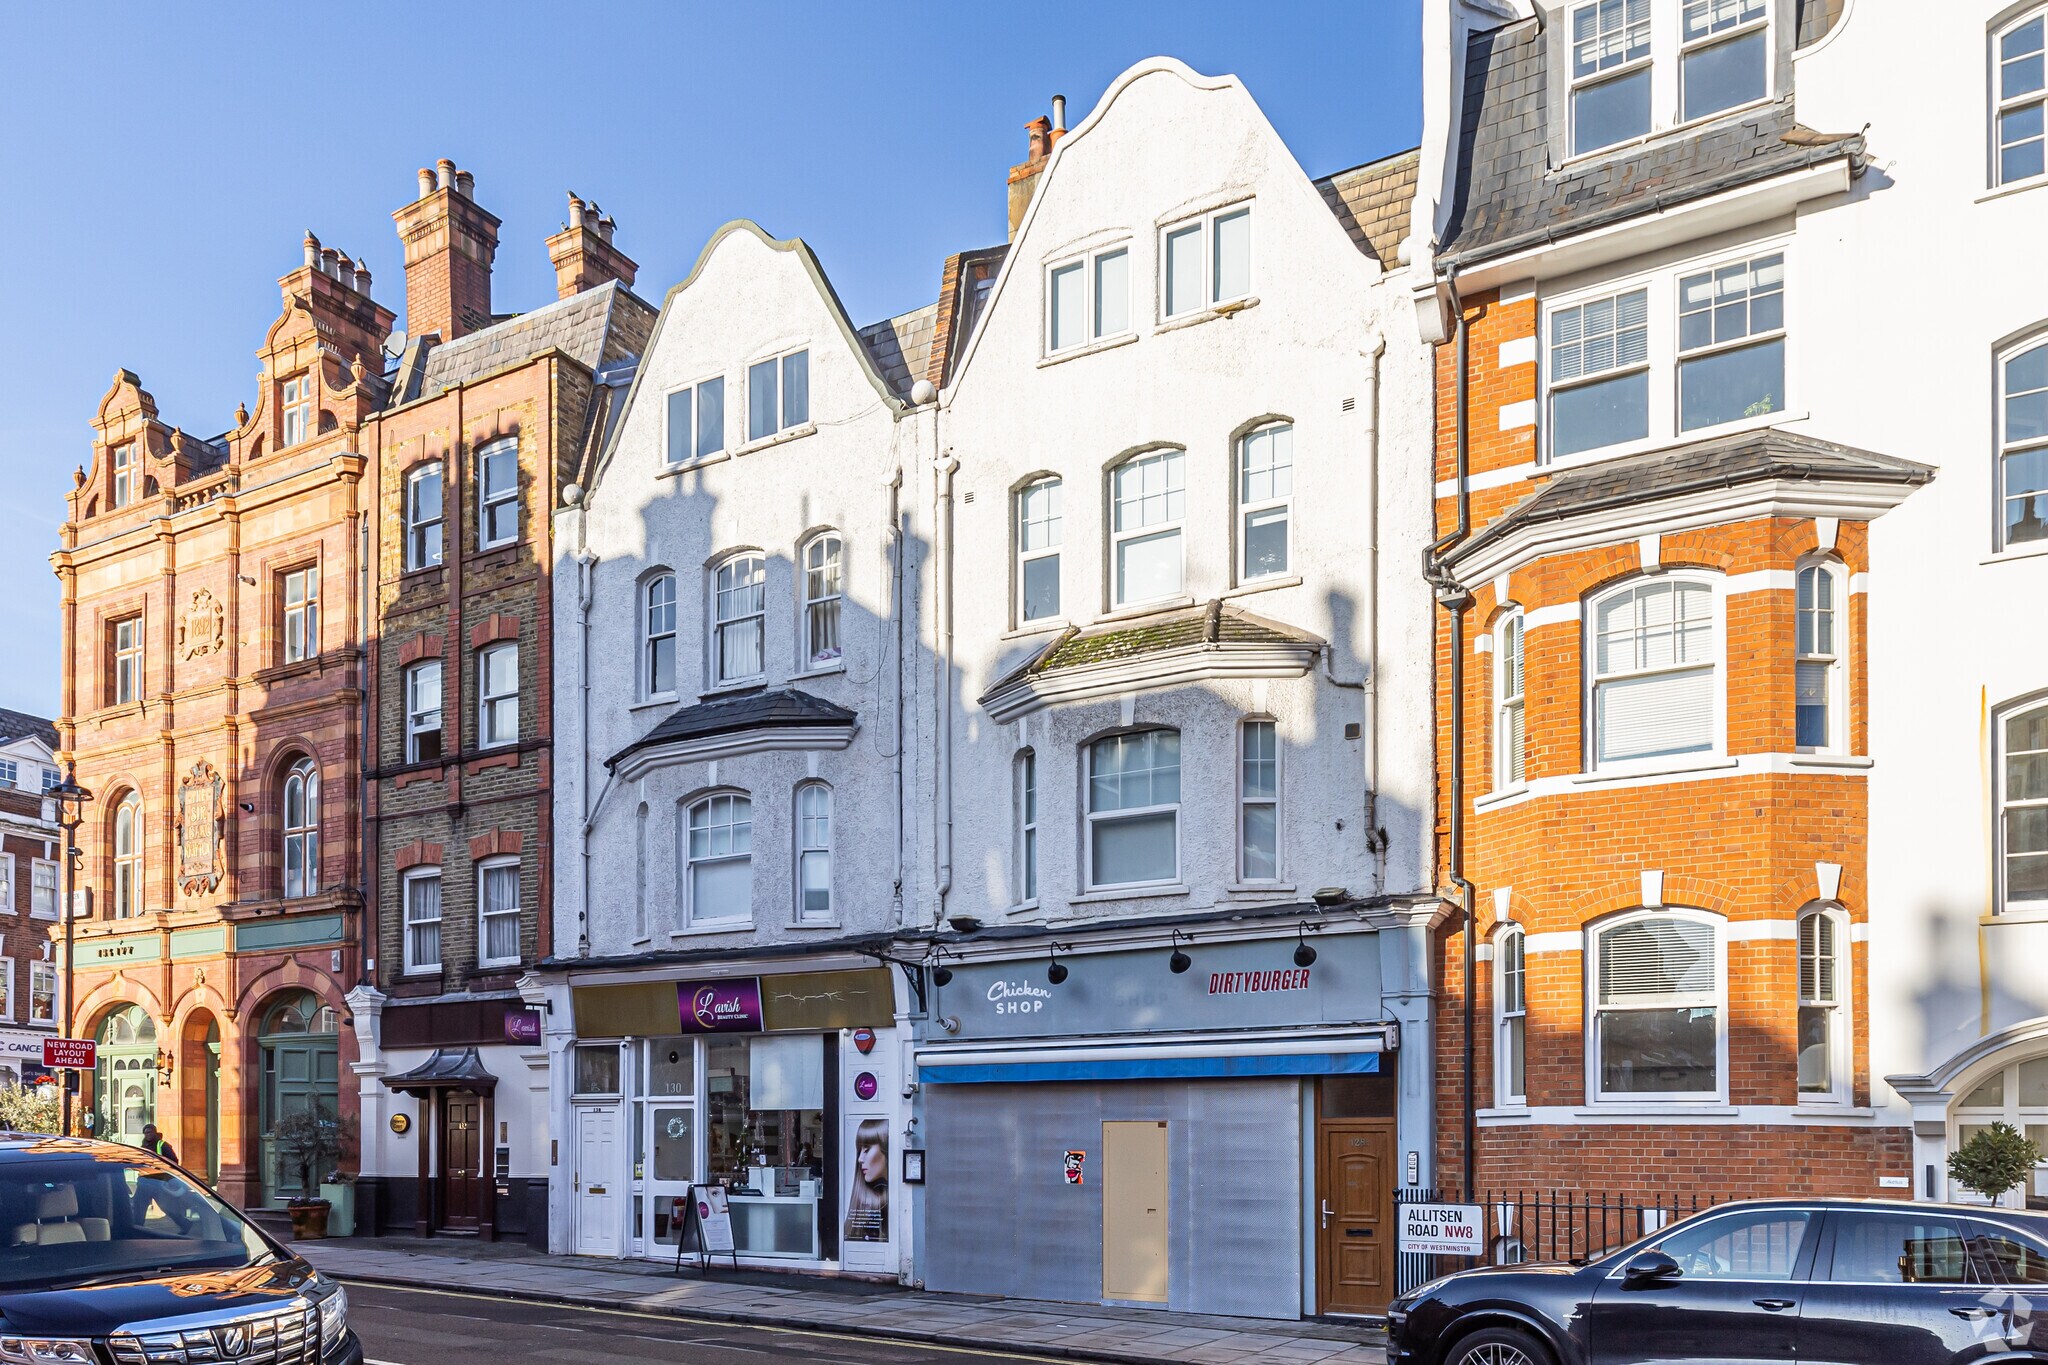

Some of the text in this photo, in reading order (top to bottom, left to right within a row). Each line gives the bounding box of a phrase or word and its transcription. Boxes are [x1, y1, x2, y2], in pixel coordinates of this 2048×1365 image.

[191, 805, 207, 821] SIR
[1208, 969, 1310, 995] DIRTYBURGER
[987, 980, 1051, 1001] Chicken
[697, 992, 740, 1020] Lavish
[996, 1000, 1043, 1014] SHOP
[8, 1043, 42, 1053] CANCE
[46, 1041, 93, 1051] NEW ROAD
[53, 1049, 86, 1058] LAYOUT
[54, 1057, 85, 1065] AHEAD
[665, 1082, 682, 1093] 130
[1408, 1209, 1463, 1223] ALLITSEN
[1407, 1224, 1473, 1239] ROAD NW8
[1430, 1244, 1471, 1252] WESTMINSTER
